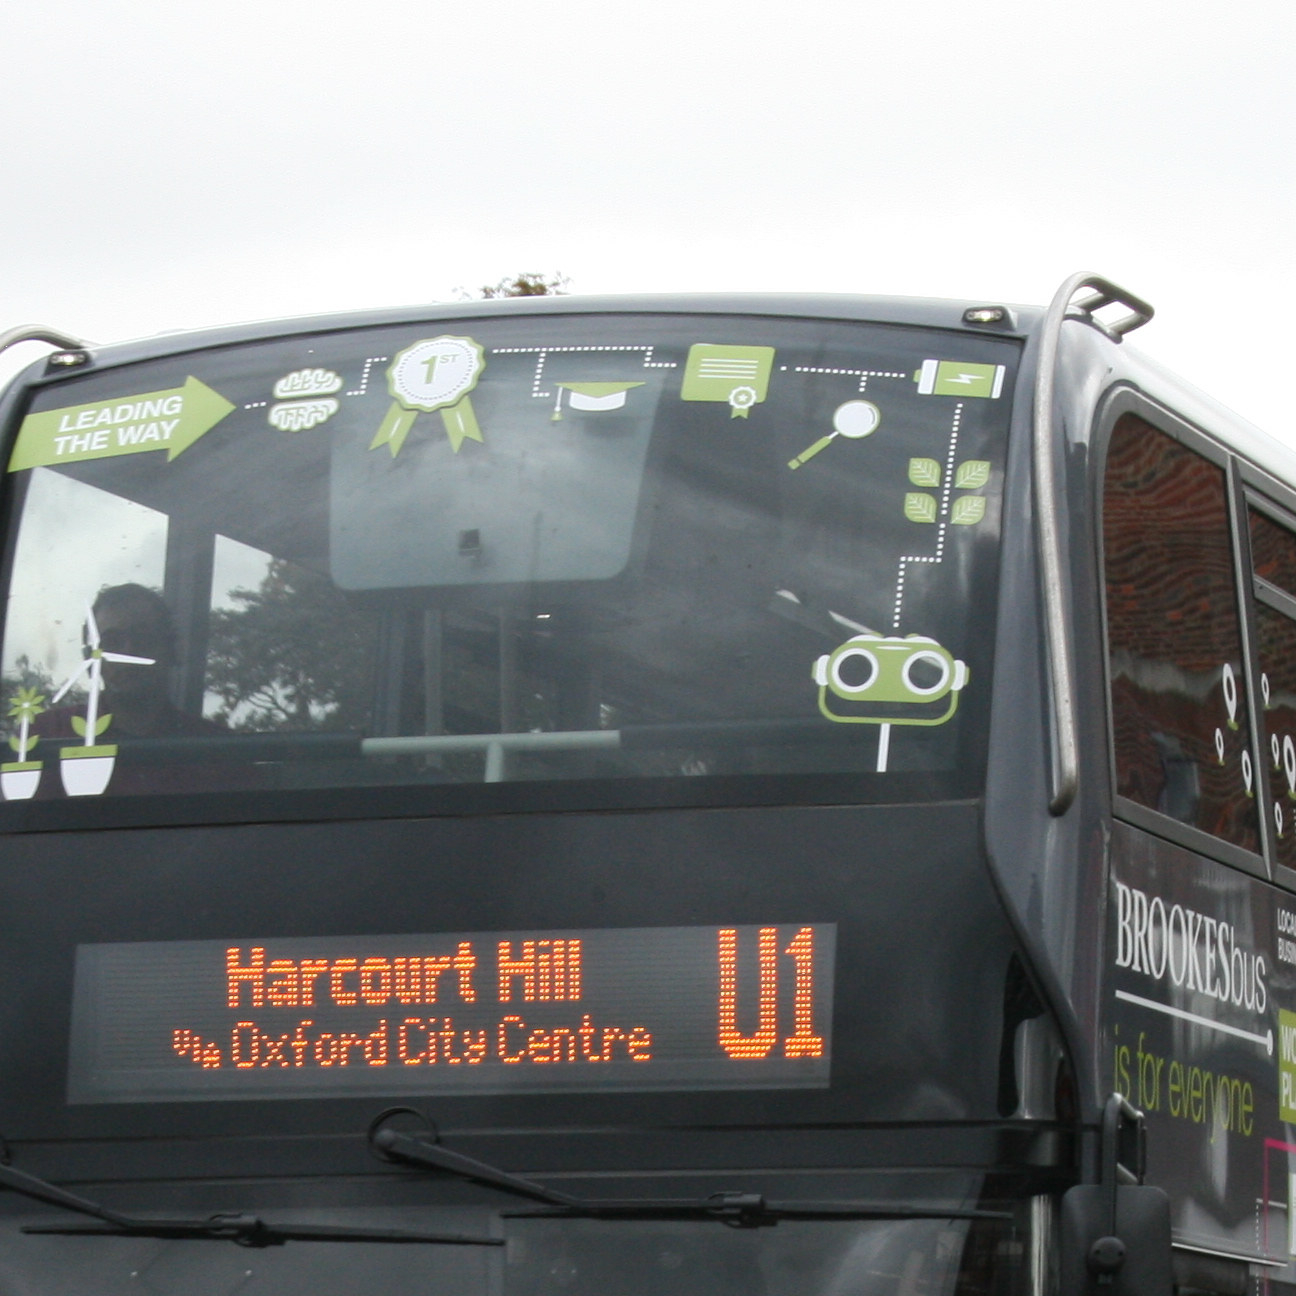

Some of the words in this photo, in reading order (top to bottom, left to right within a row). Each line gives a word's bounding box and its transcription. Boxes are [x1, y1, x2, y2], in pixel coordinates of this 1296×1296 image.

[419, 352, 460, 386] 1ST
[54, 432, 114, 455] THE
[117, 419, 181, 447] WAY
[58, 395, 183, 433] LEADING
[226, 941, 476, 1007] Harcourt
[498, 939, 581, 1002] Hill
[718, 927, 823, 1058] U1
[231, 1018, 387, 1069] Oxford
[400, 1017, 487, 1067] City
[498, 1014, 651, 1064] Centre
[1114, 1023, 1131, 1101] is
[1137, 1031, 1164, 1112] for
[1168, 1059, 1254, 1144] everyone
